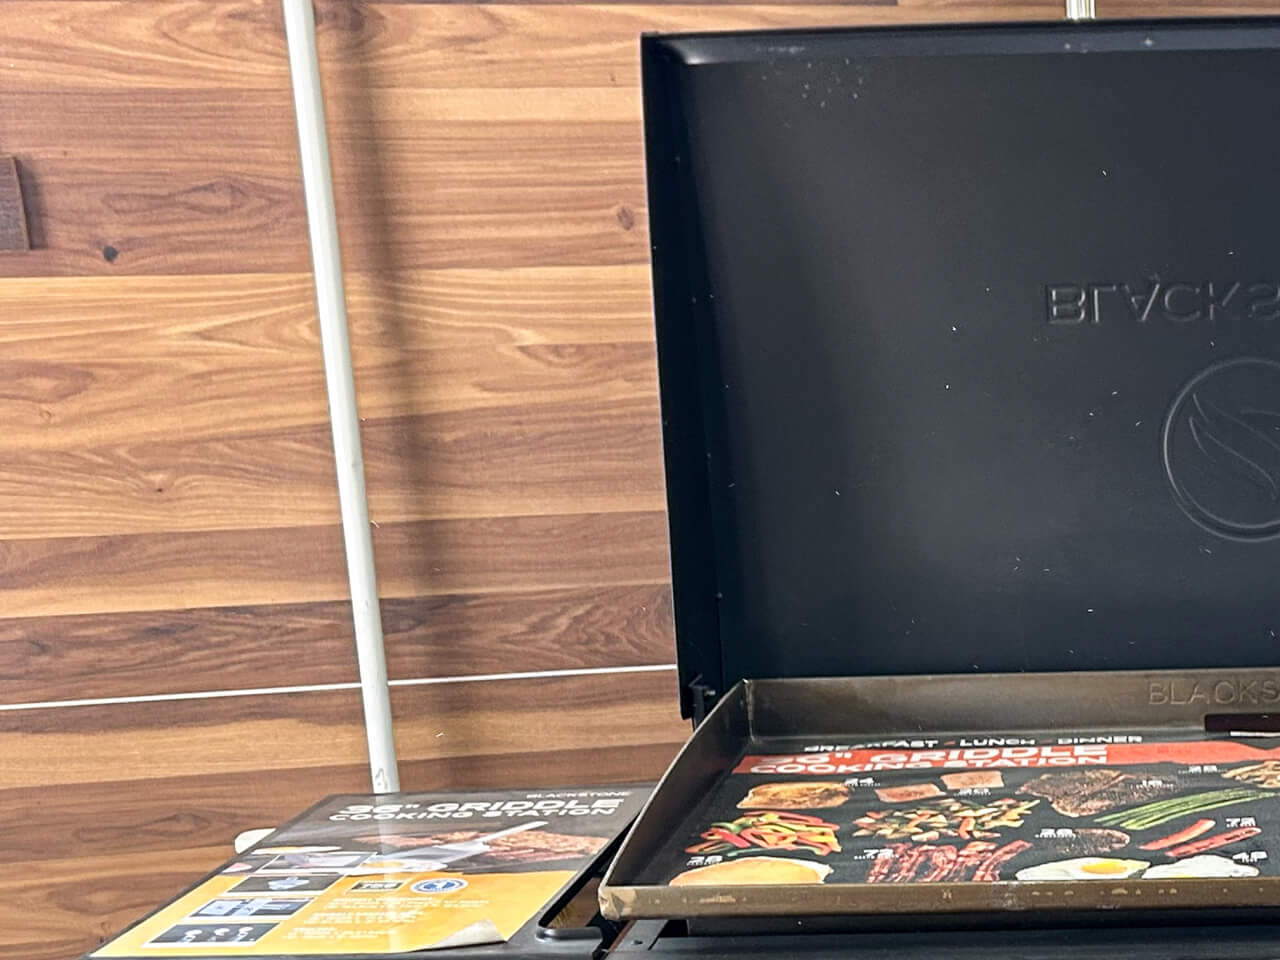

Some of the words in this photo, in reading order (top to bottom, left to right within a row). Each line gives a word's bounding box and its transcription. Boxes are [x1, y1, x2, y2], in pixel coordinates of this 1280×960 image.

[960, 738, 1035, 747] LUNCH
[1057, 735, 1142, 744] DINNER
[870, 744, 1107, 763] GRIDDLE
[750, 761, 932, 774] COOKING
[943, 756, 1107, 768] STATION
[329, 812, 473, 821] COOKING
[483, 807, 615, 818] STATION
[338, 803, 420, 814] 36"
[427, 798, 624, 812] GRIDDLE
